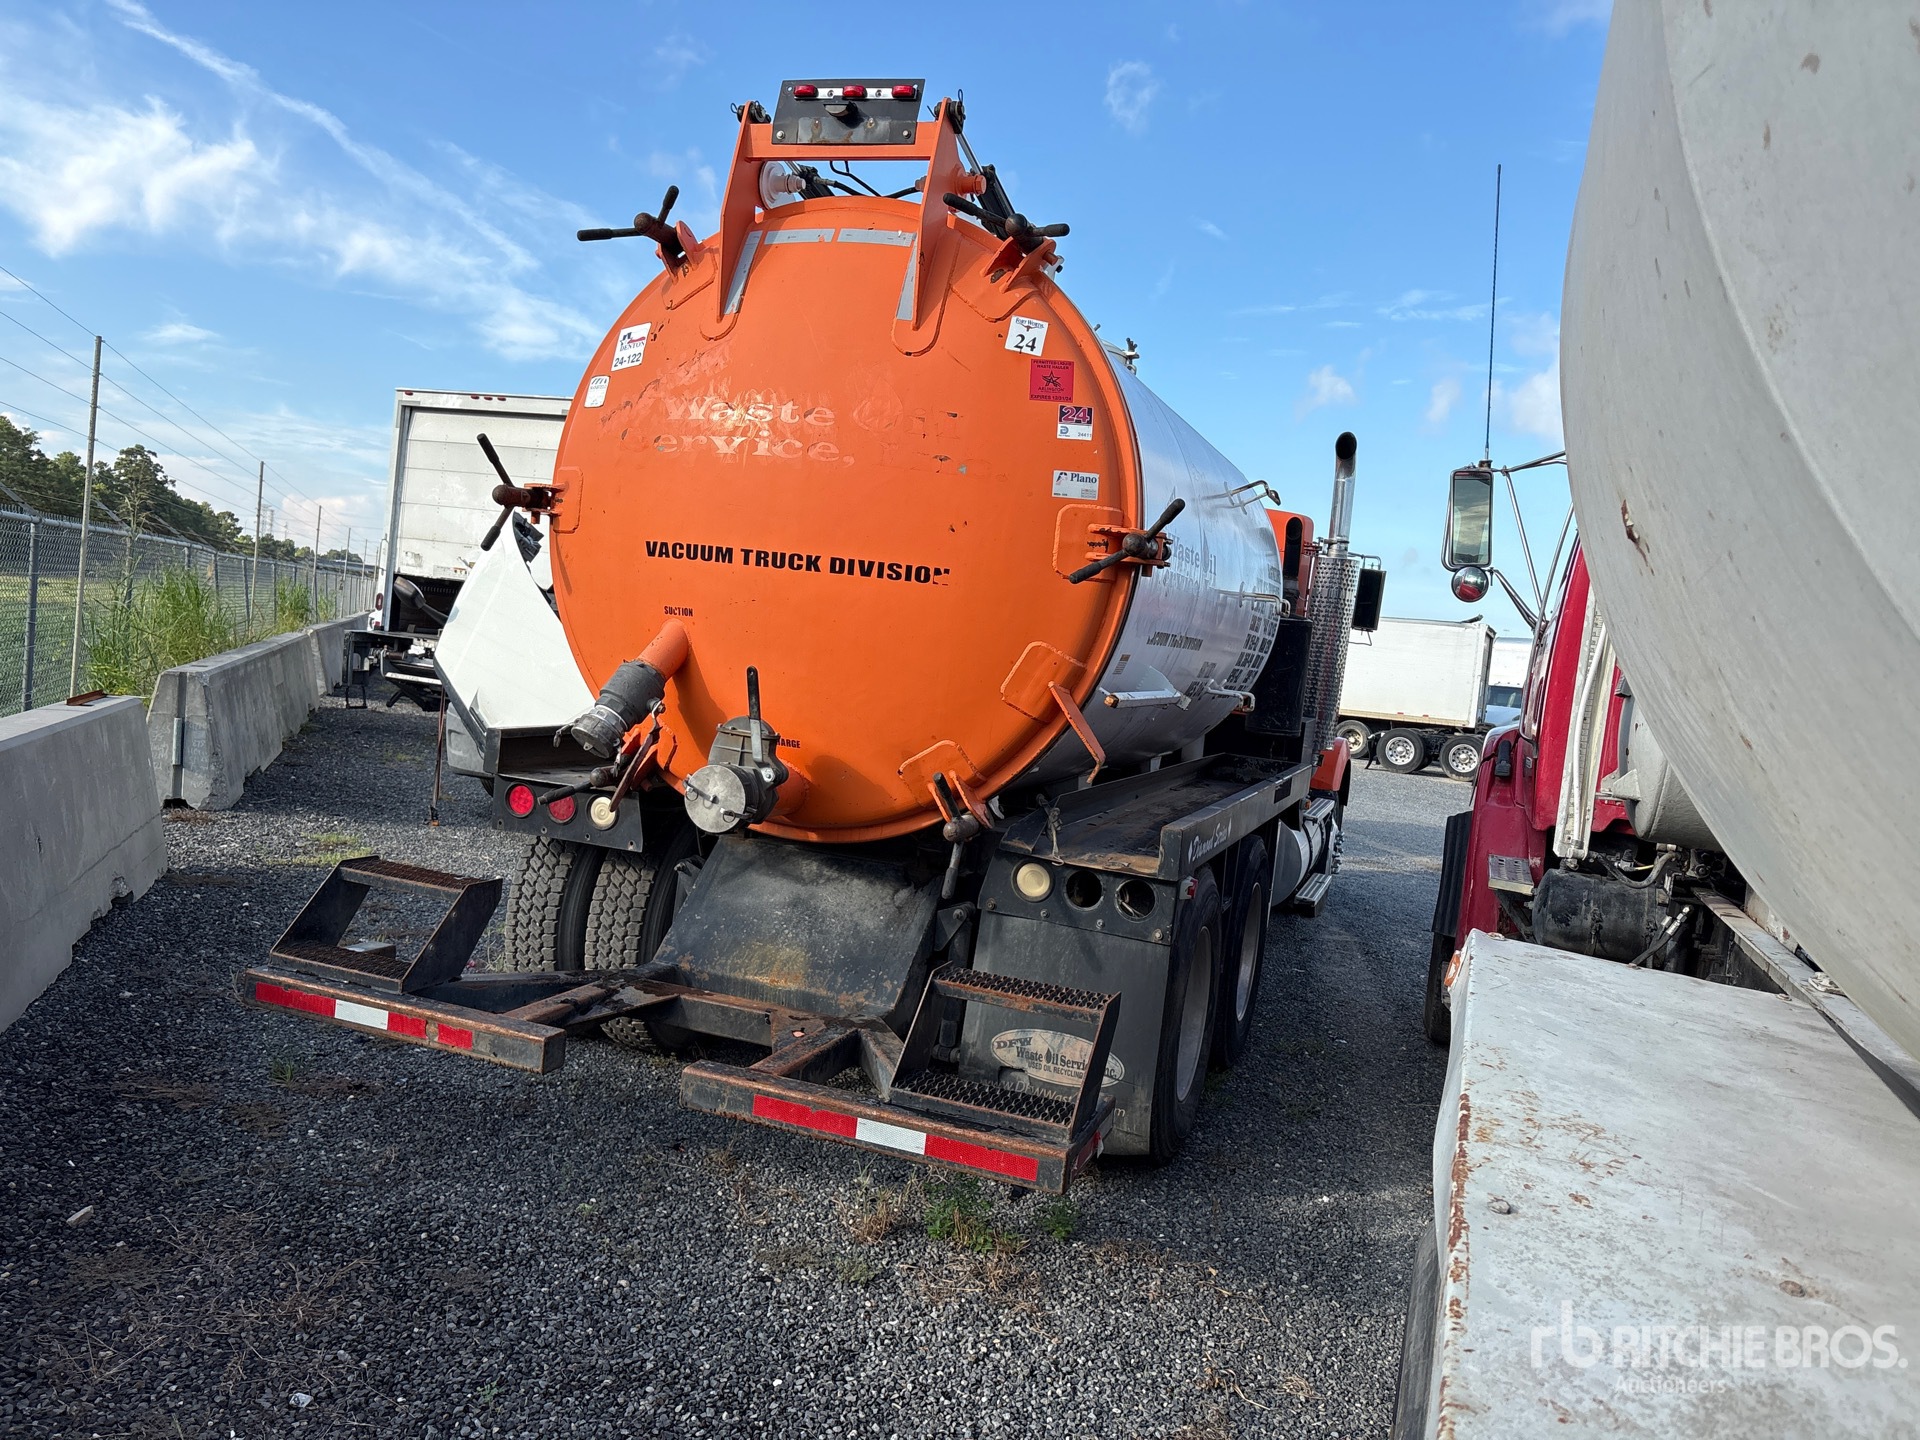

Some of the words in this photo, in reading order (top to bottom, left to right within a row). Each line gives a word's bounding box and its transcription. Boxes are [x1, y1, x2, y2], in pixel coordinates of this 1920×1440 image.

[620, 342, 645, 352] DENTON
[1013, 333, 1037, 352] 24
[613, 352, 642, 368] 24-122
[1062, 405, 1090, 424] 24
[640, 429, 856, 468] ervice,
[1070, 472, 1098, 484] Plano
[645, 541, 734, 564] VACUUM
[740, 548, 822, 572] TRUCK
[664, 605, 694, 617] SUCTION
[995, 1037, 1033, 1049] DFW
[1016, 1046, 1043, 1062] Waste
[1060, 1054, 1086, 1071] Servi
[1028, 1061, 1042, 1070] USED
[1044, 1064, 1053, 1073] OIL
